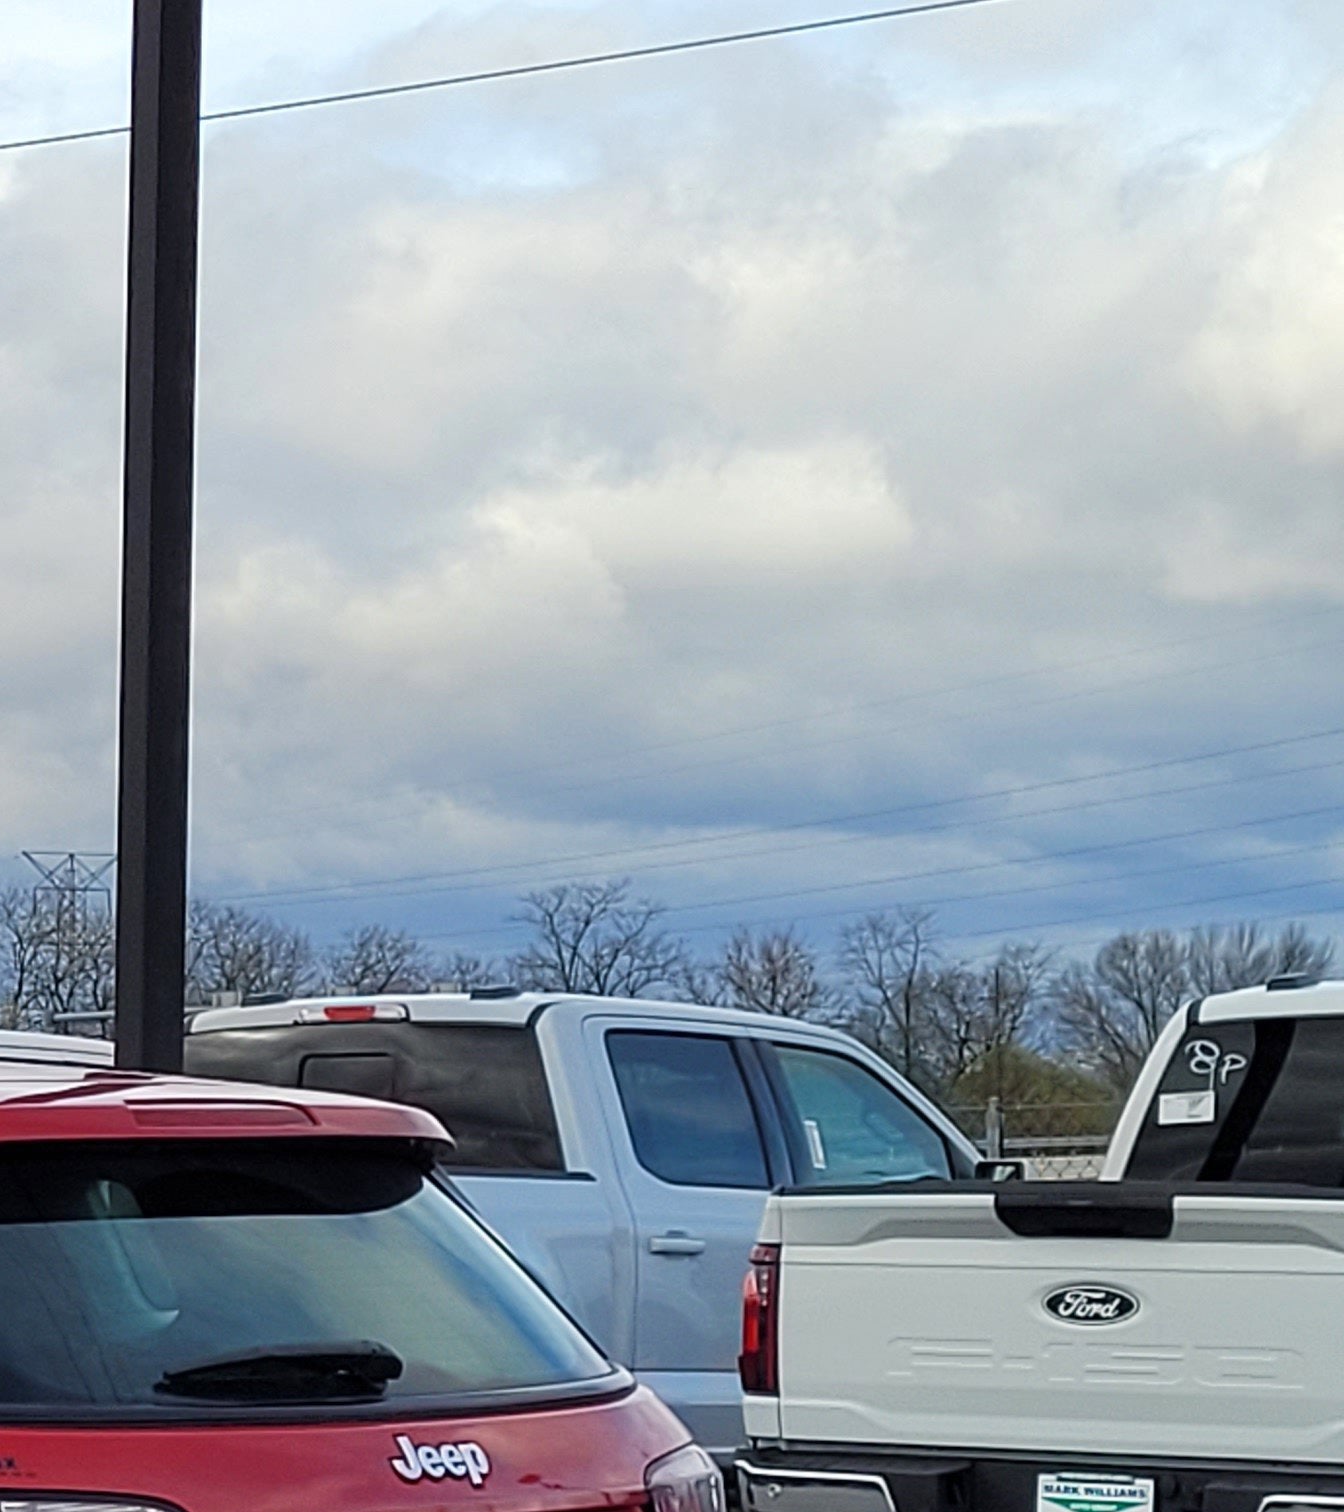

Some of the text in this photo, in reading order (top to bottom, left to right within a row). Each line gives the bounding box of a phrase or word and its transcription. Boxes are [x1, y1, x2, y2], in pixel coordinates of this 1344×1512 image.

[1058, 1290, 1121, 1318] Ford
[390, 1434, 491, 1487] Jeep
[1083, 1486, 1147, 1498] WILLIAMS
